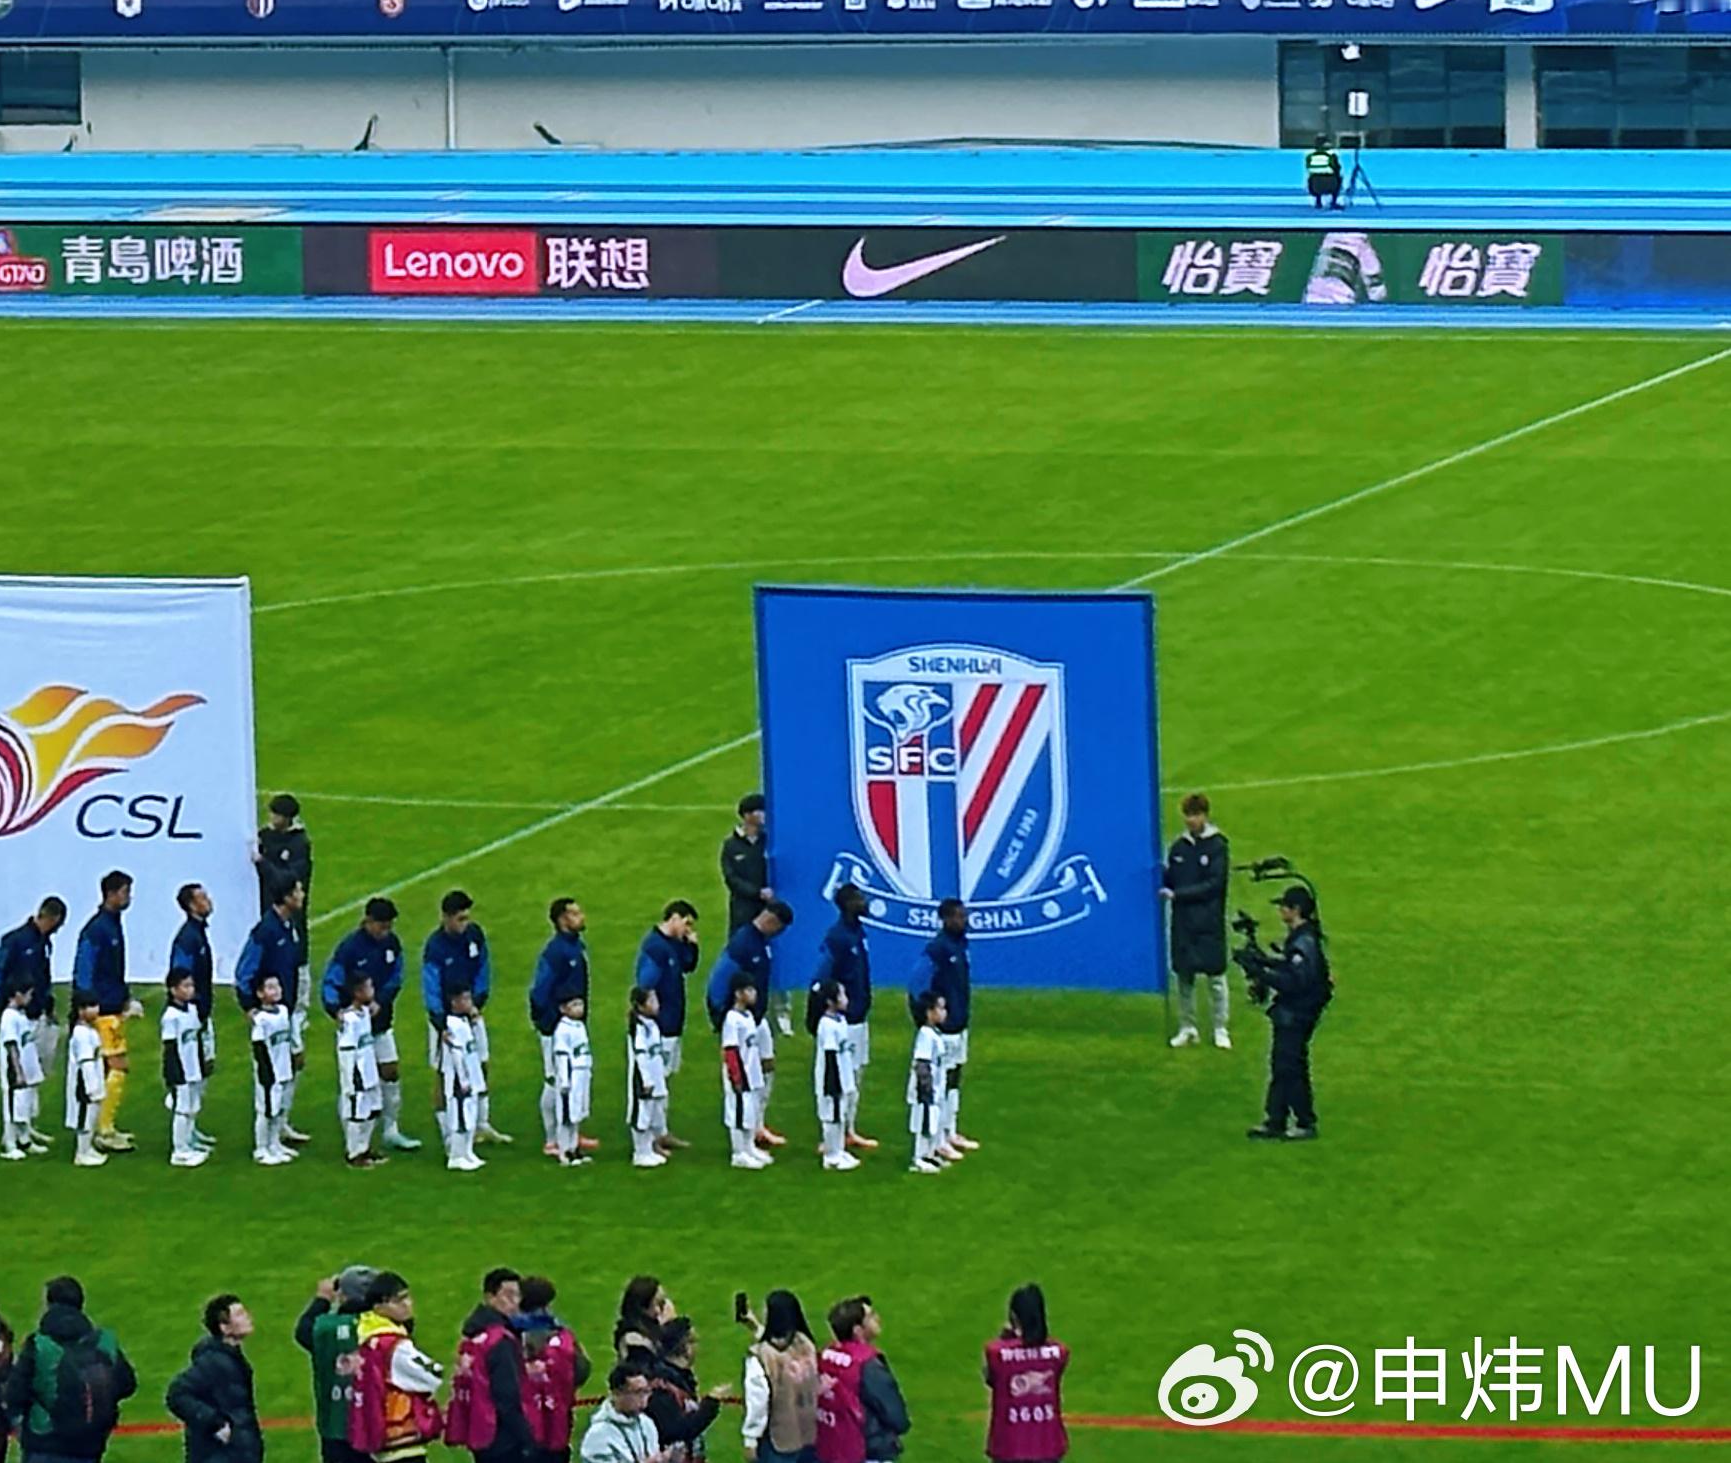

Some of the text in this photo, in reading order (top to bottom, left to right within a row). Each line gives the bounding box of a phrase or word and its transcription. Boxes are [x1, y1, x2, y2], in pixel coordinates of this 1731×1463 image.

[383, 242, 525, 279] Lenovo
[545, 237, 650, 290] 联想
[1160, 240, 1284, 295] 怡寶
[1418, 241, 1542, 298] 怡寶
[907, 655, 1003, 675] SHENHUA
[867, 745, 957, 773] SFC
[75, 794, 204, 839] CSL
[907, 906, 1024, 930] SHGHAI
